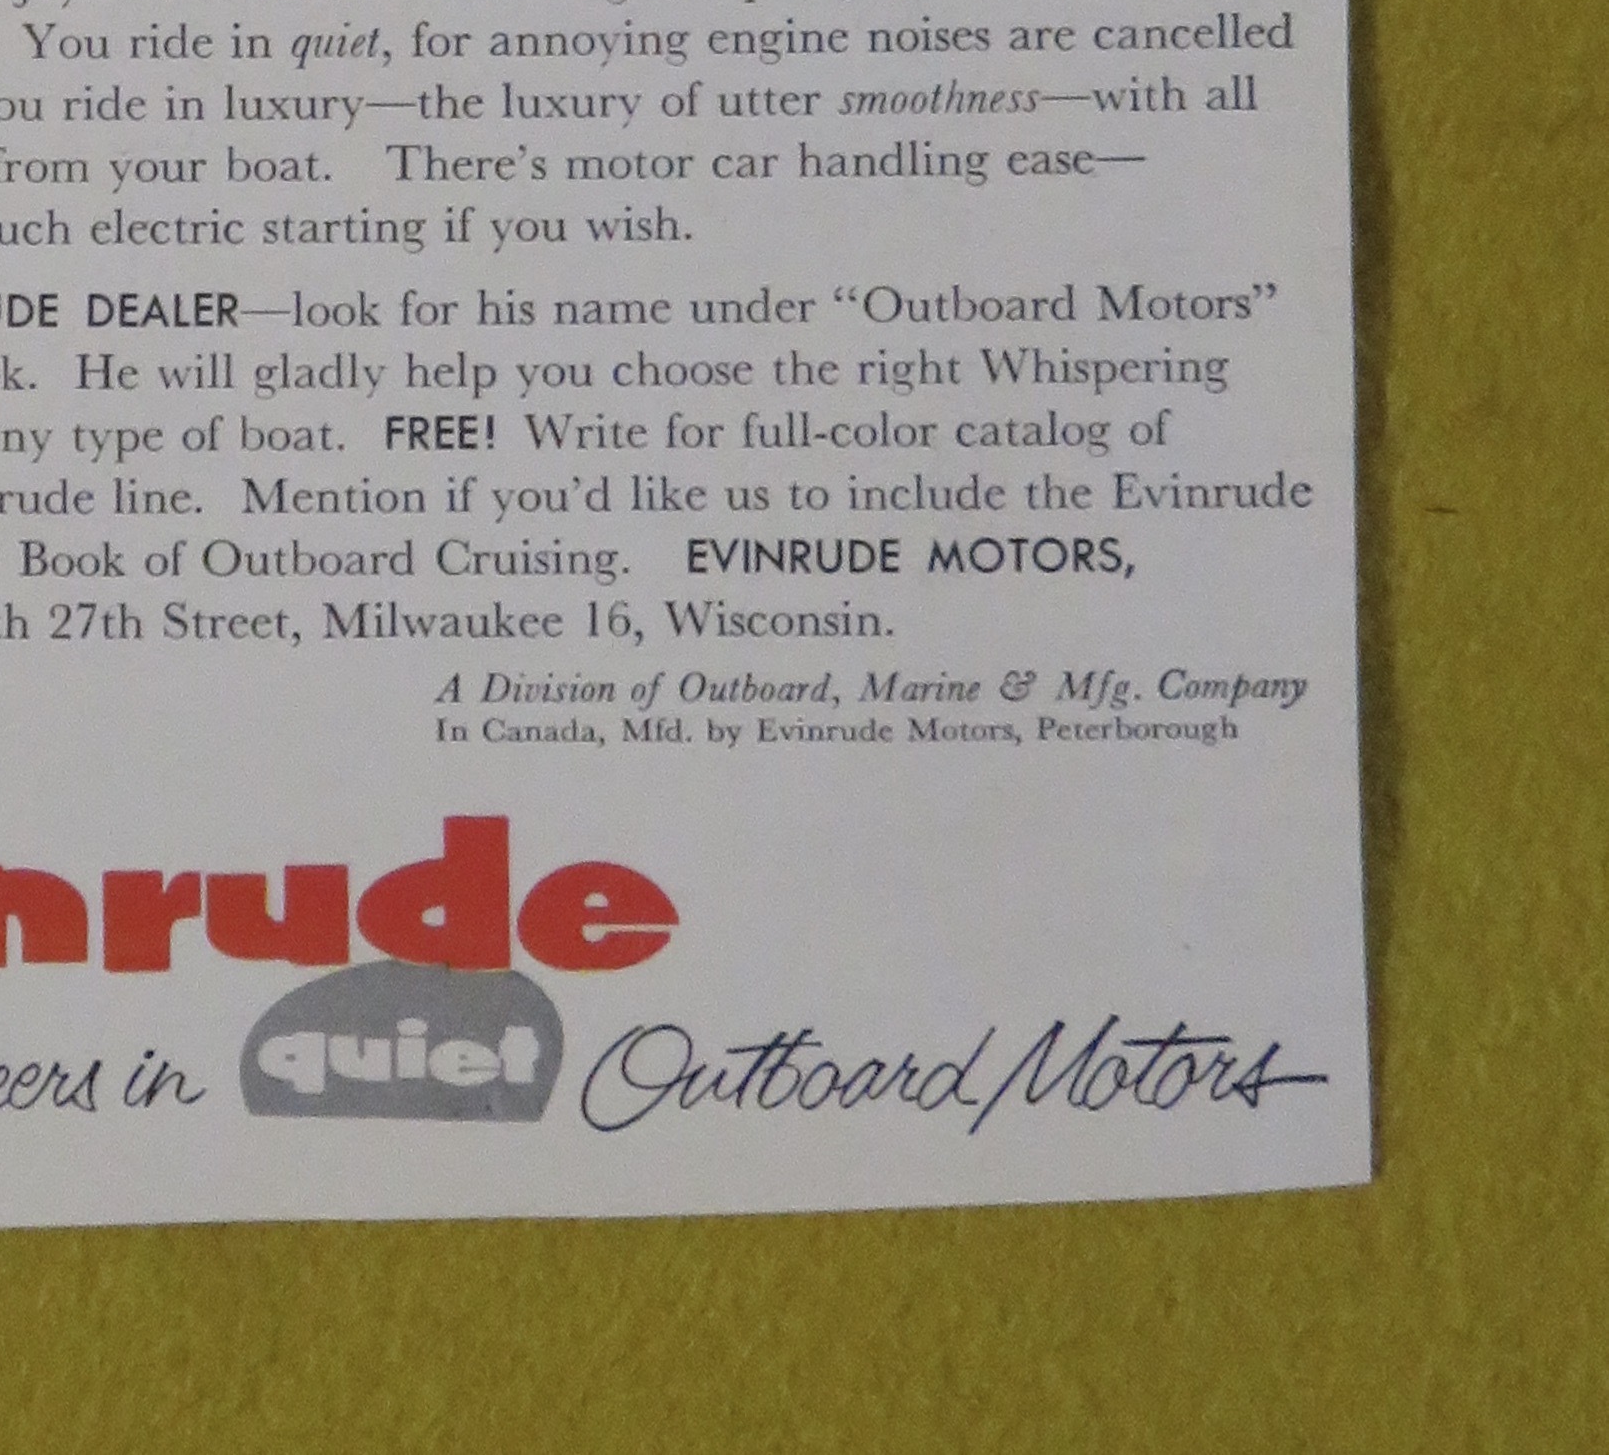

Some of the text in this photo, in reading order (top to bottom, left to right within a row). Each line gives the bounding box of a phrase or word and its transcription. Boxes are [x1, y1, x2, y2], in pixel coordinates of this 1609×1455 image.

[22, 23, 109, 59] You
[131, 23, 213, 59] ride
[231, 22, 272, 59] in
[291, 22, 391, 69] quiet,
[412, 20, 472, 57] for
[489, 19, 690, 67] annoying
[708, 18, 848, 64] engine
[868, 16, 991, 53] noises
[1009, 27, 1075, 51] are
[1093, 12, 1294, 50] cancelled
[90, 208, 244, 245] electric
[263, 207, 426, 254] starting
[445, 206, 476, 242] if
[491, 218, 567, 253] you
[586, 205, 692, 241] wish.
[76, 353, 138, 390] He
[158, 352, 234, 389] will
[255, 352, 386, 398] gladly
[407, 351, 497, 399] help
[516, 363, 593, 398] you
[613, 350, 753, 387] choose
[774, 350, 839, 386] the
[858, 348, 960, 392] right
[980, 347, 1229, 395] Whispering
[73, 425, 163, 463] type
[182, 415, 224, 451] of
[241, 415, 344, 451] boat.
[386, 414, 495, 451] FREE!
[524, 413, 647, 449] Write
[666, 412, 724, 448] for
[744, 411, 937, 448] full-color
[955, 410, 1111, 456] catalog
[1130, 408, 1172, 446] of
[19, 540, 125, 577] Book
[145, 540, 187, 577] of
[202, 539, 414, 577] Outboard
[436, 538, 629, 586] Cruising.
[687, 538, 900, 574] EVINRUDE
[927, 536, 1135, 579] MOTORS,
[49, 602, 143, 640] 27th
[164, 602, 301, 647] Street,
[323, 601, 563, 639] Milwaukee
[588, 601, 644, 646] 16,
[664, 600, 893, 637] Wisconsin.
[435, 668, 1308, 711] A Division of Outboard, Marine & Mfg. Company
[437, 715, 1238, 748] In Canada, Mfd. by Evinrude Motors, Peterborough
[124, 1050, 206, 1108] in
[258, 1017, 539, 1095] quiet
[580, 1024, 996, 1132] Outboard
[968, 1014, 1329, 1135] Motors
